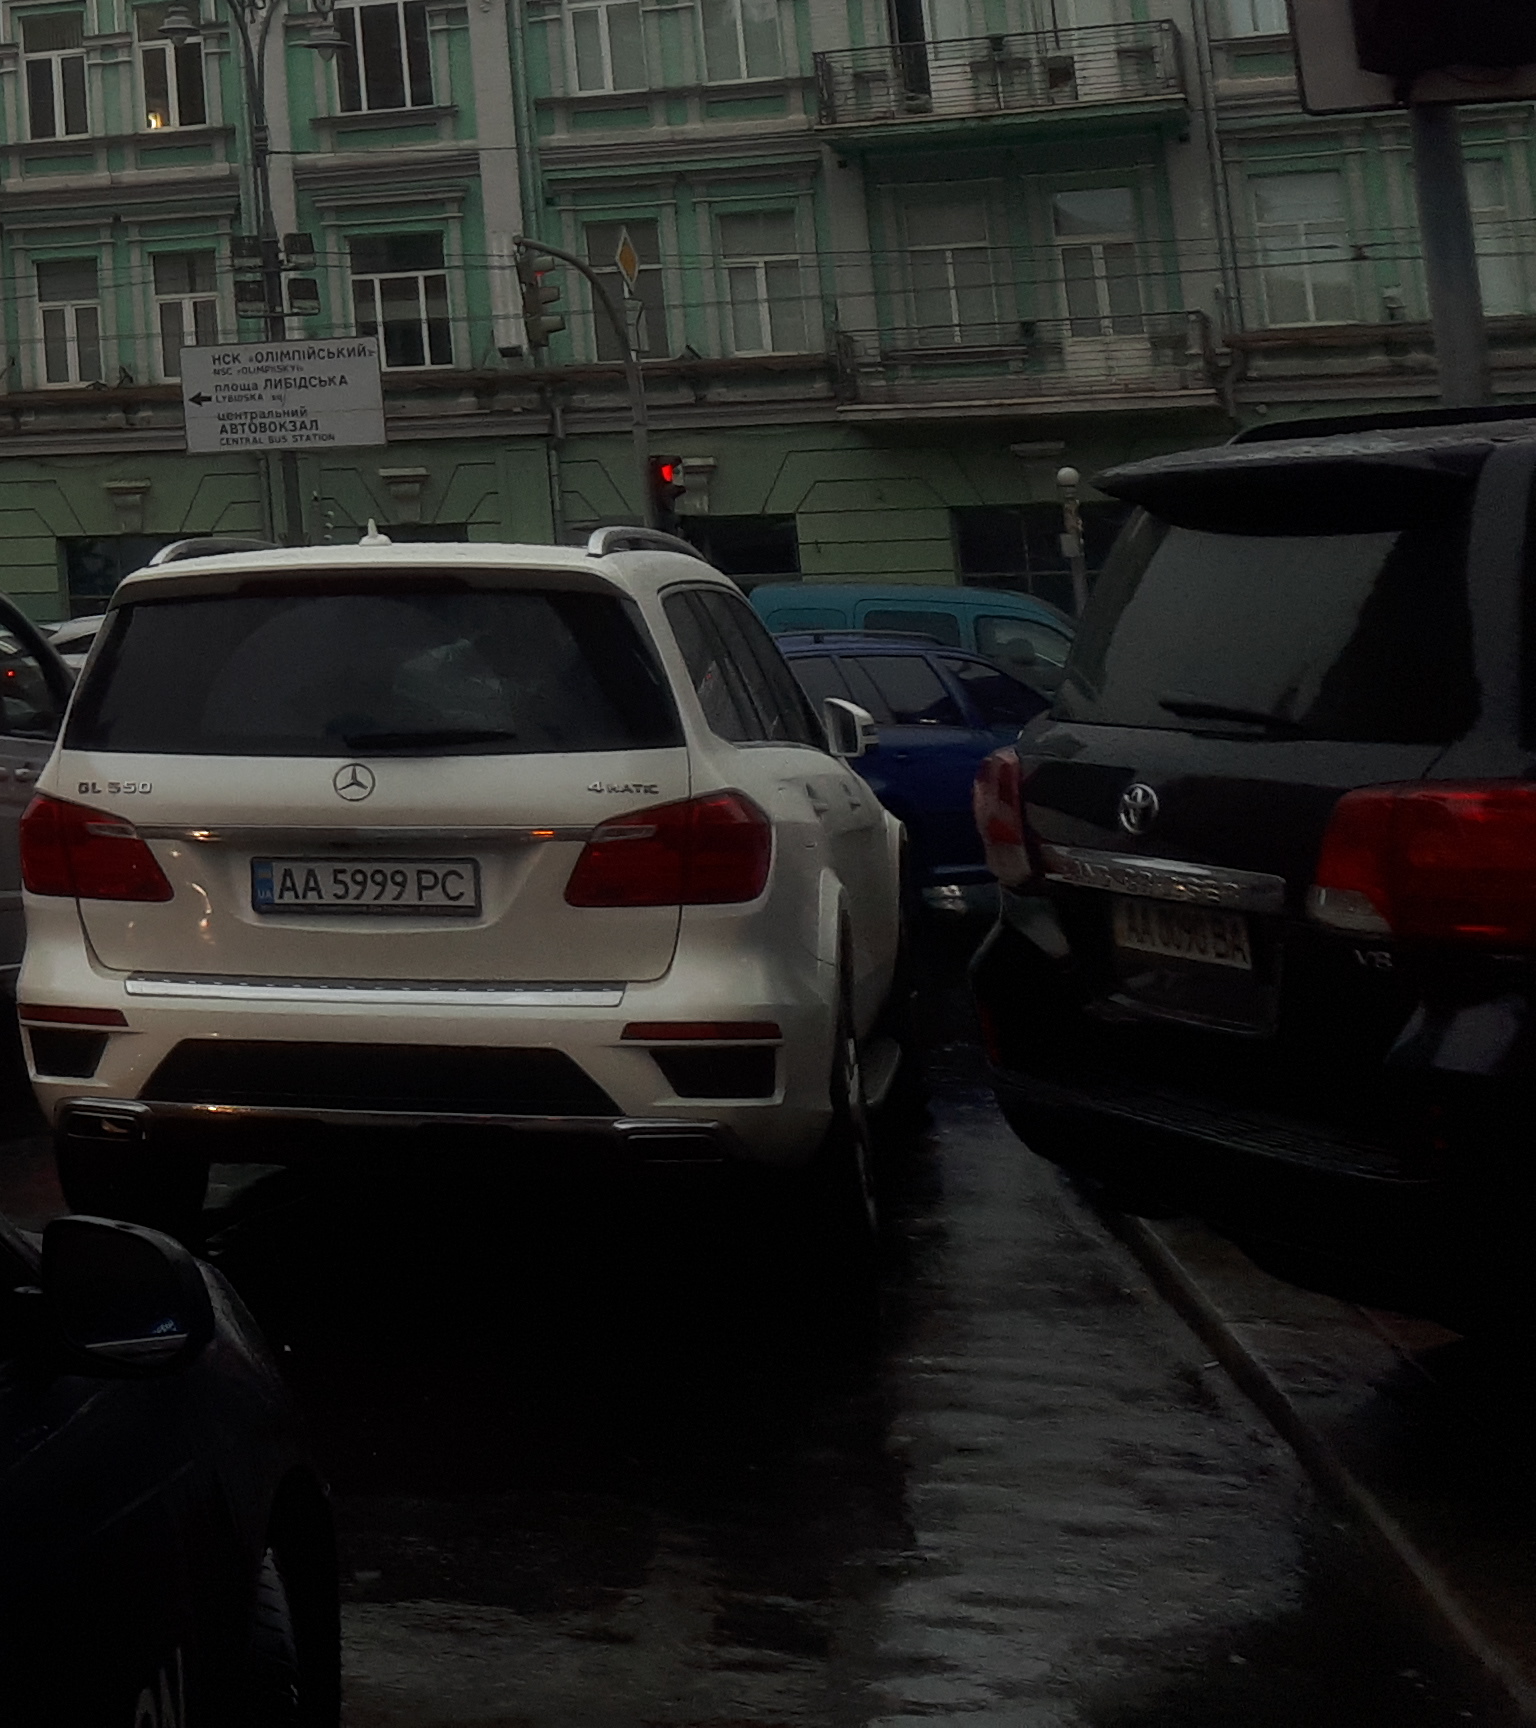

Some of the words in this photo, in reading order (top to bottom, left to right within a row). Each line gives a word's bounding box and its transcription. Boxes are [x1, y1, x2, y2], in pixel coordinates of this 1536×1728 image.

[211, 352, 242, 365] НСК
[212, 367, 232, 376] NSC
[214, 381, 259, 393] площа
[263, 375, 349, 390] ЛИБІДСЬКА
[215, 393, 264, 404] LYBIDSKA
[217, 406, 308, 424] центральний
[219, 419, 319, 435] АВТОВОКЗАЛ
[219, 436, 264, 446] CENTRAL
[268, 435, 288, 445] BUS
[292, 433, 336, 443] STATION
[78, 781, 102, 794] GL
[107, 780, 153, 794] 550
[277, 867, 325, 901] AA
[332, 868, 409, 901] 5999
[416, 869, 465, 902] PC
